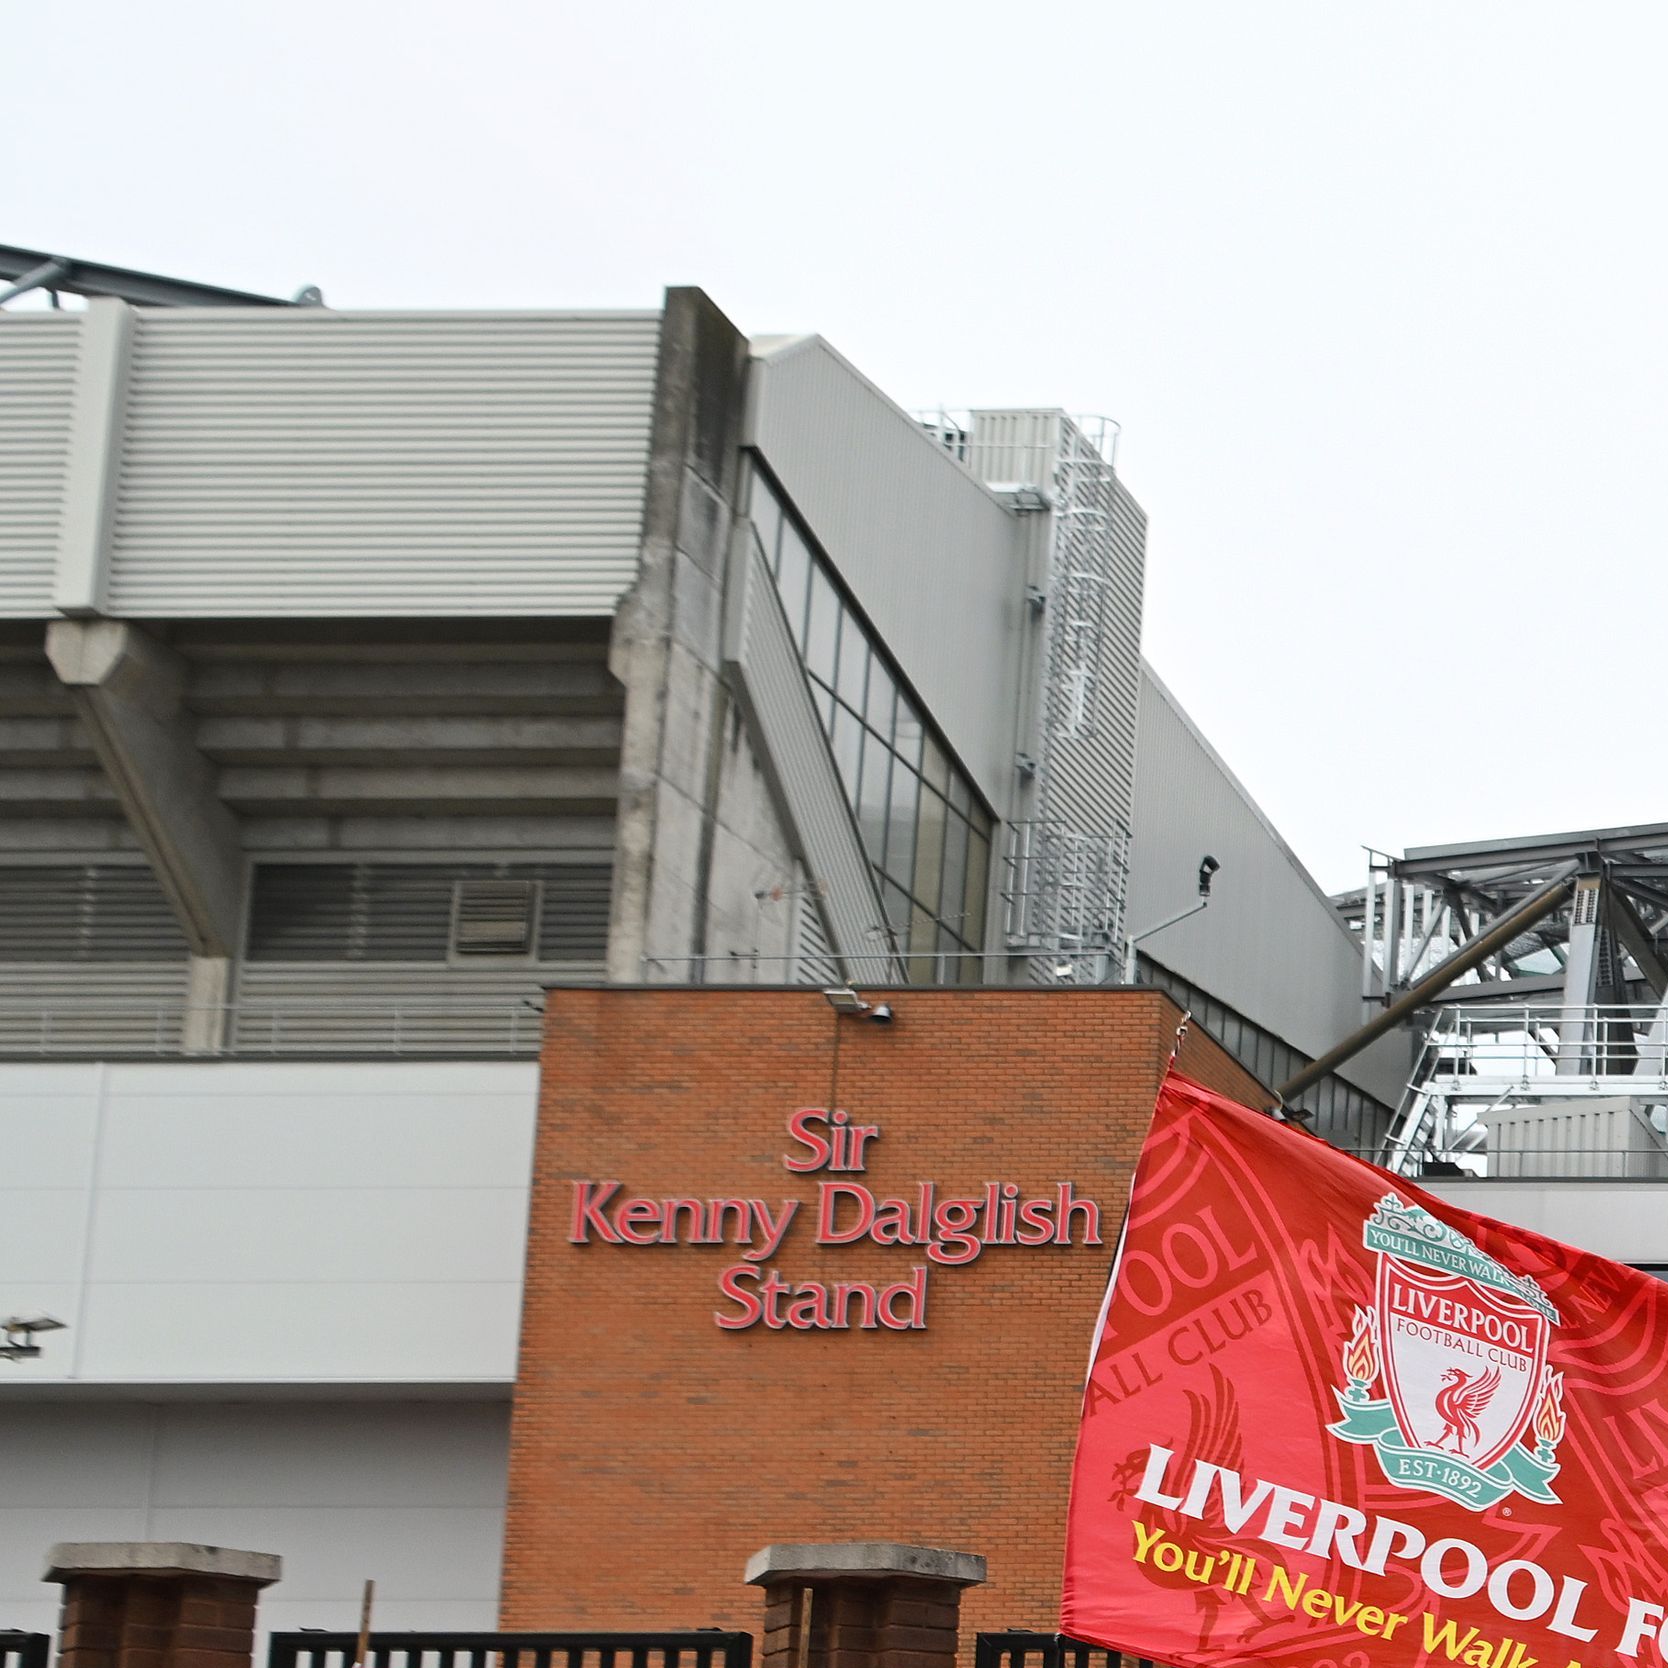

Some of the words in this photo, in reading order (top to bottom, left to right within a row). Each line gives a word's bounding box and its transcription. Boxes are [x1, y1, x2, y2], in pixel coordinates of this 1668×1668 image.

[782, 1106, 879, 1172] Sir
[567, 1179, 803, 1262] Kenny
[815, 1179, 1103, 1266] Dalglish
[1421, 1245, 1471, 1275] NEVER
[713, 1263, 928, 1331] Stand
[1167, 1287, 1273, 1367] CLUB
[1391, 1283, 1535, 1354] LIVERPOOL
[1396, 1317, 1484, 1359] FOOTBALL
[1487, 1346, 1528, 1373] CLUB
[1132, 1442, 1599, 1643] LIVERPOOL
[1131, 1520, 1254, 1596] You'll
[1262, 1564, 1408, 1641] Never
